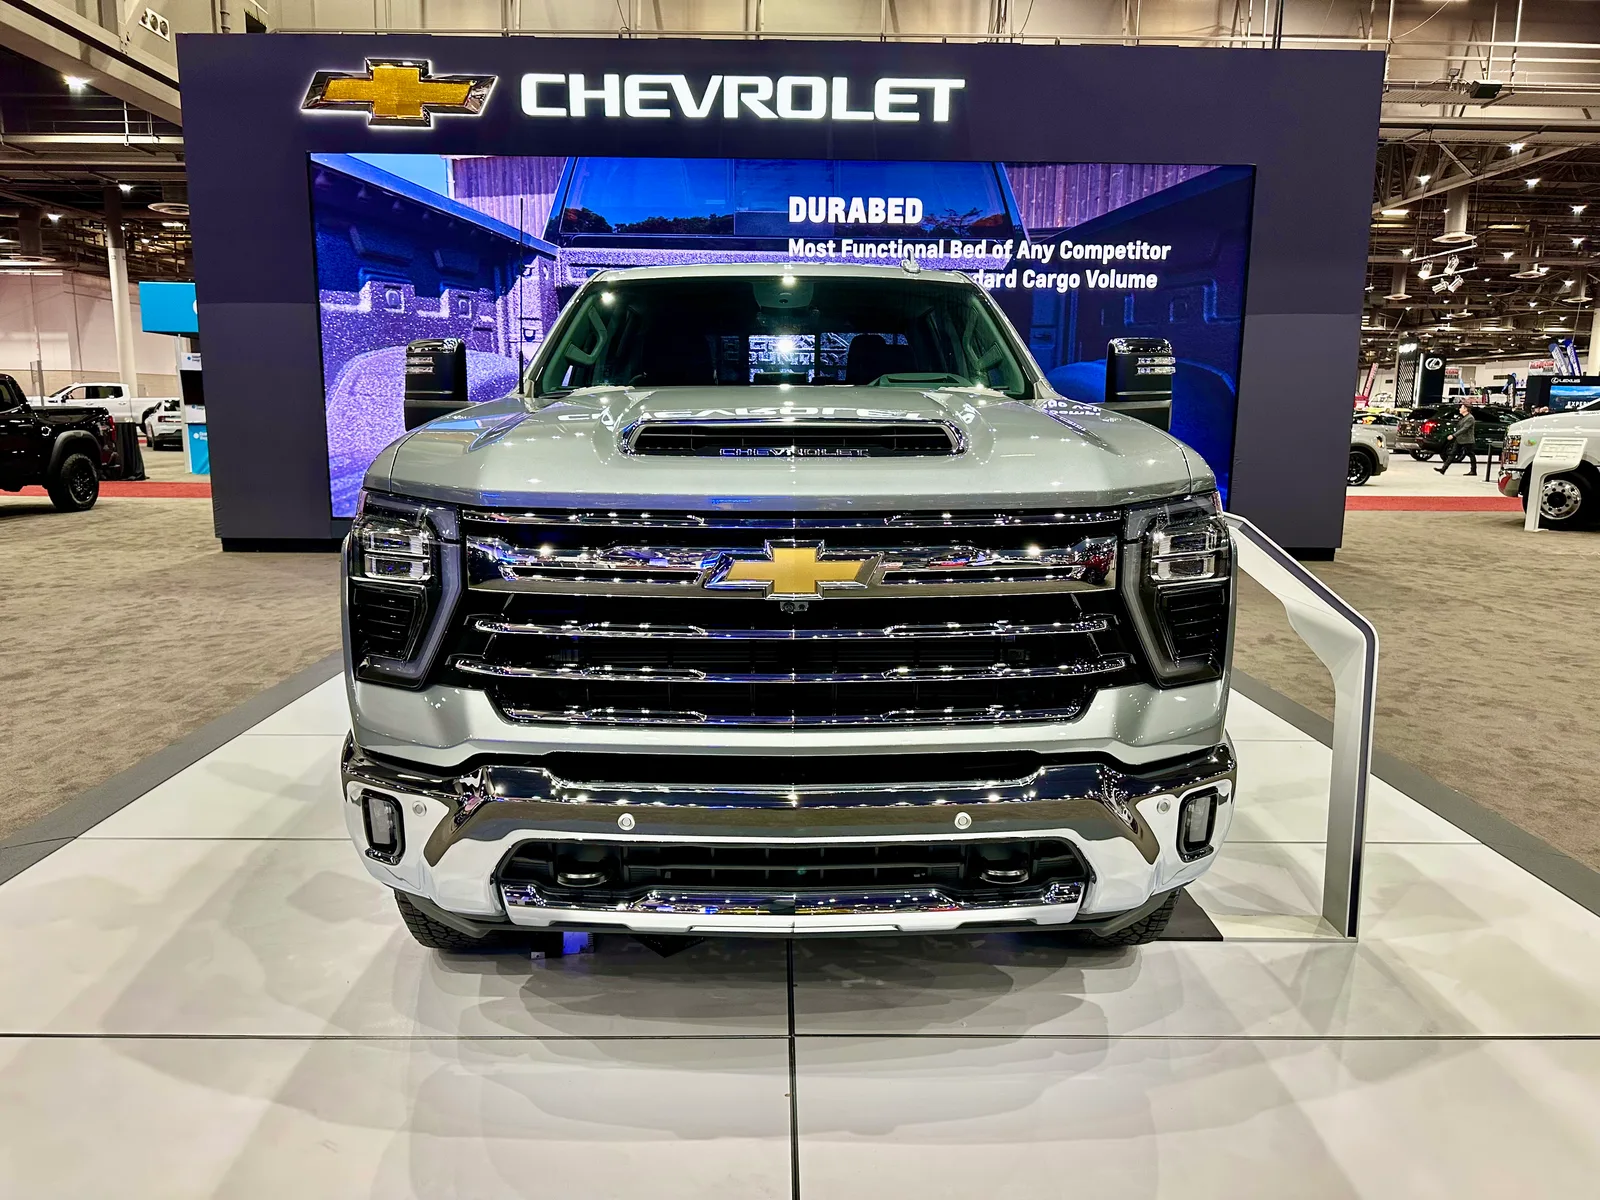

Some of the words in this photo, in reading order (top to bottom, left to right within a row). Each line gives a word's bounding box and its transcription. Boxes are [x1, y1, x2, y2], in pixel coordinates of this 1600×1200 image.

[520, 73, 966, 122] CHEVROLET
[788, 196, 923, 225] DURABED
[788, 238, 836, 259] Most
[841, 238, 944, 259] Functional
[950, 239, 987, 259] Bed
[993, 240, 1013, 259] of
[1017, 240, 1055, 264] Any
[1060, 240, 1172, 264] Competitor
[972, 269, 1017, 289] dard
[1023, 270, 1080, 293] Cargo
[1085, 269, 1158, 290] Volume
[718, 448, 870, 457] CHEVROLET
